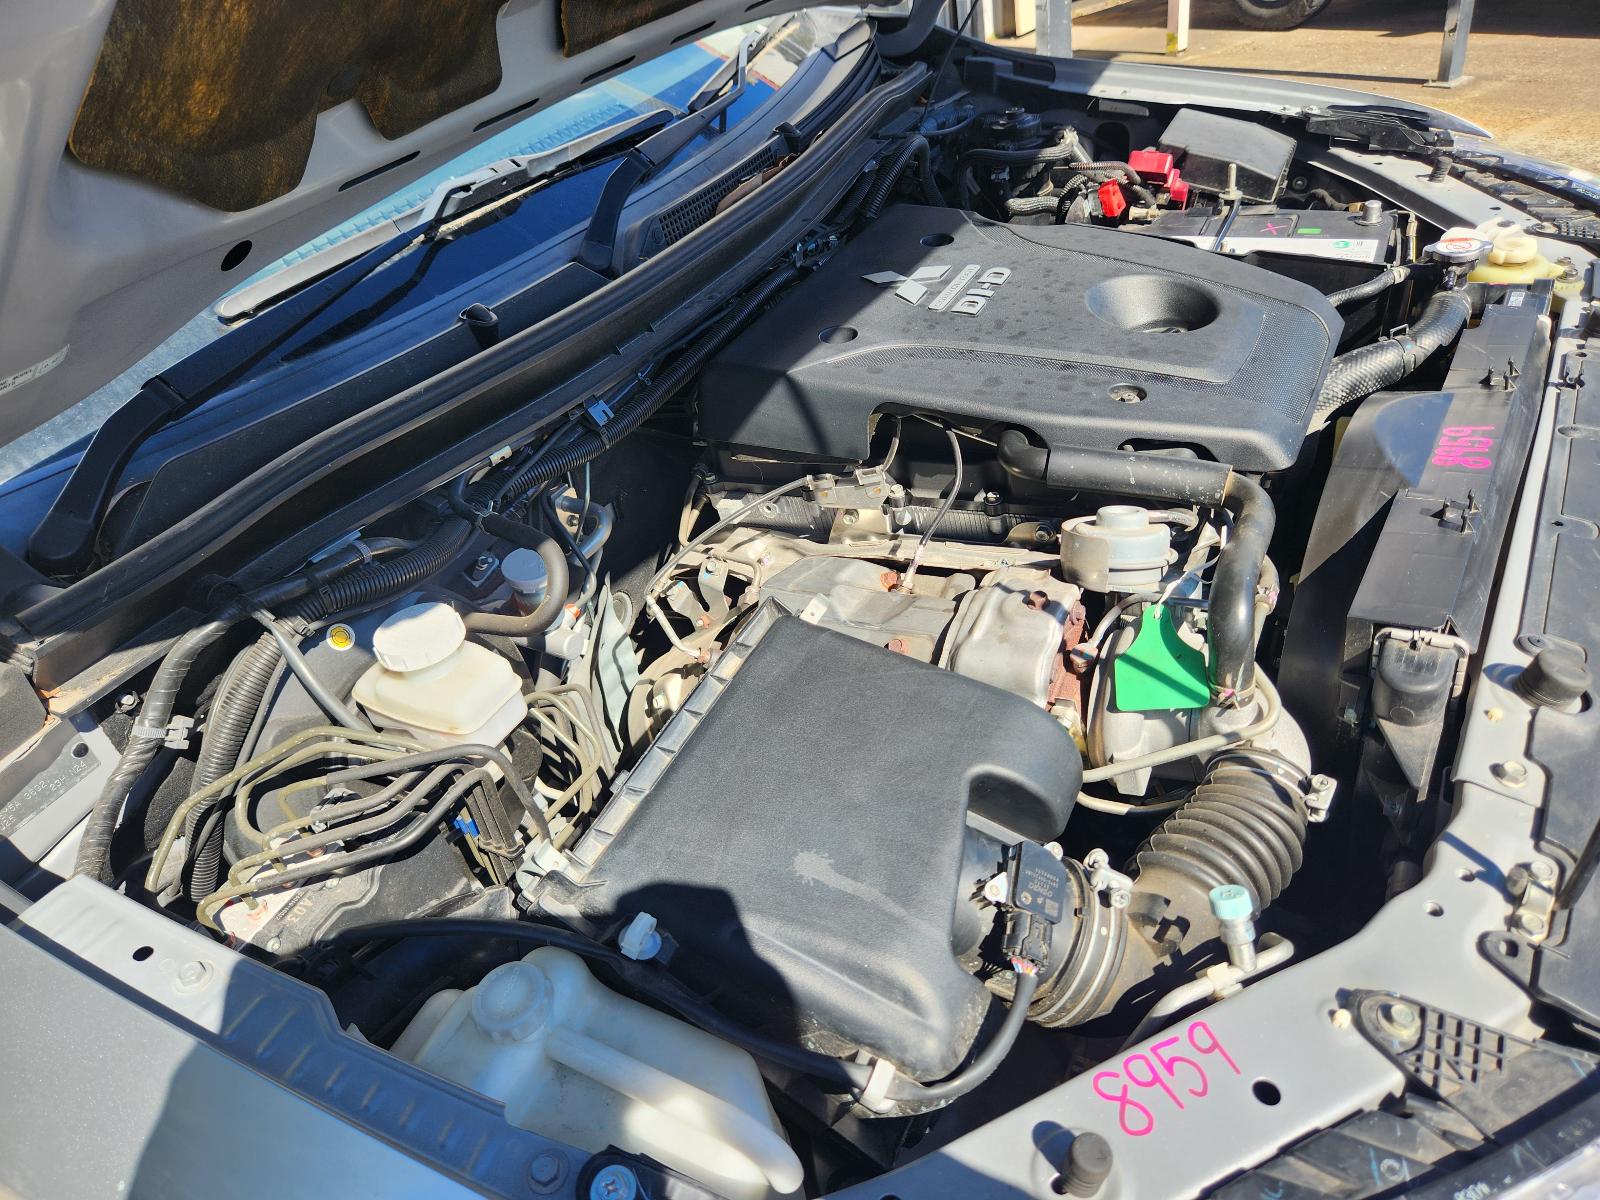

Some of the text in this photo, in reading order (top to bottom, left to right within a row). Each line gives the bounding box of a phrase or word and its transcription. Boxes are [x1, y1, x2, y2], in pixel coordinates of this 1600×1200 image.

[951, 267, 1012, 316] DI-D
[1430, 425, 1495, 469] 8959
[1092, 1019, 1241, 1137] 8959
